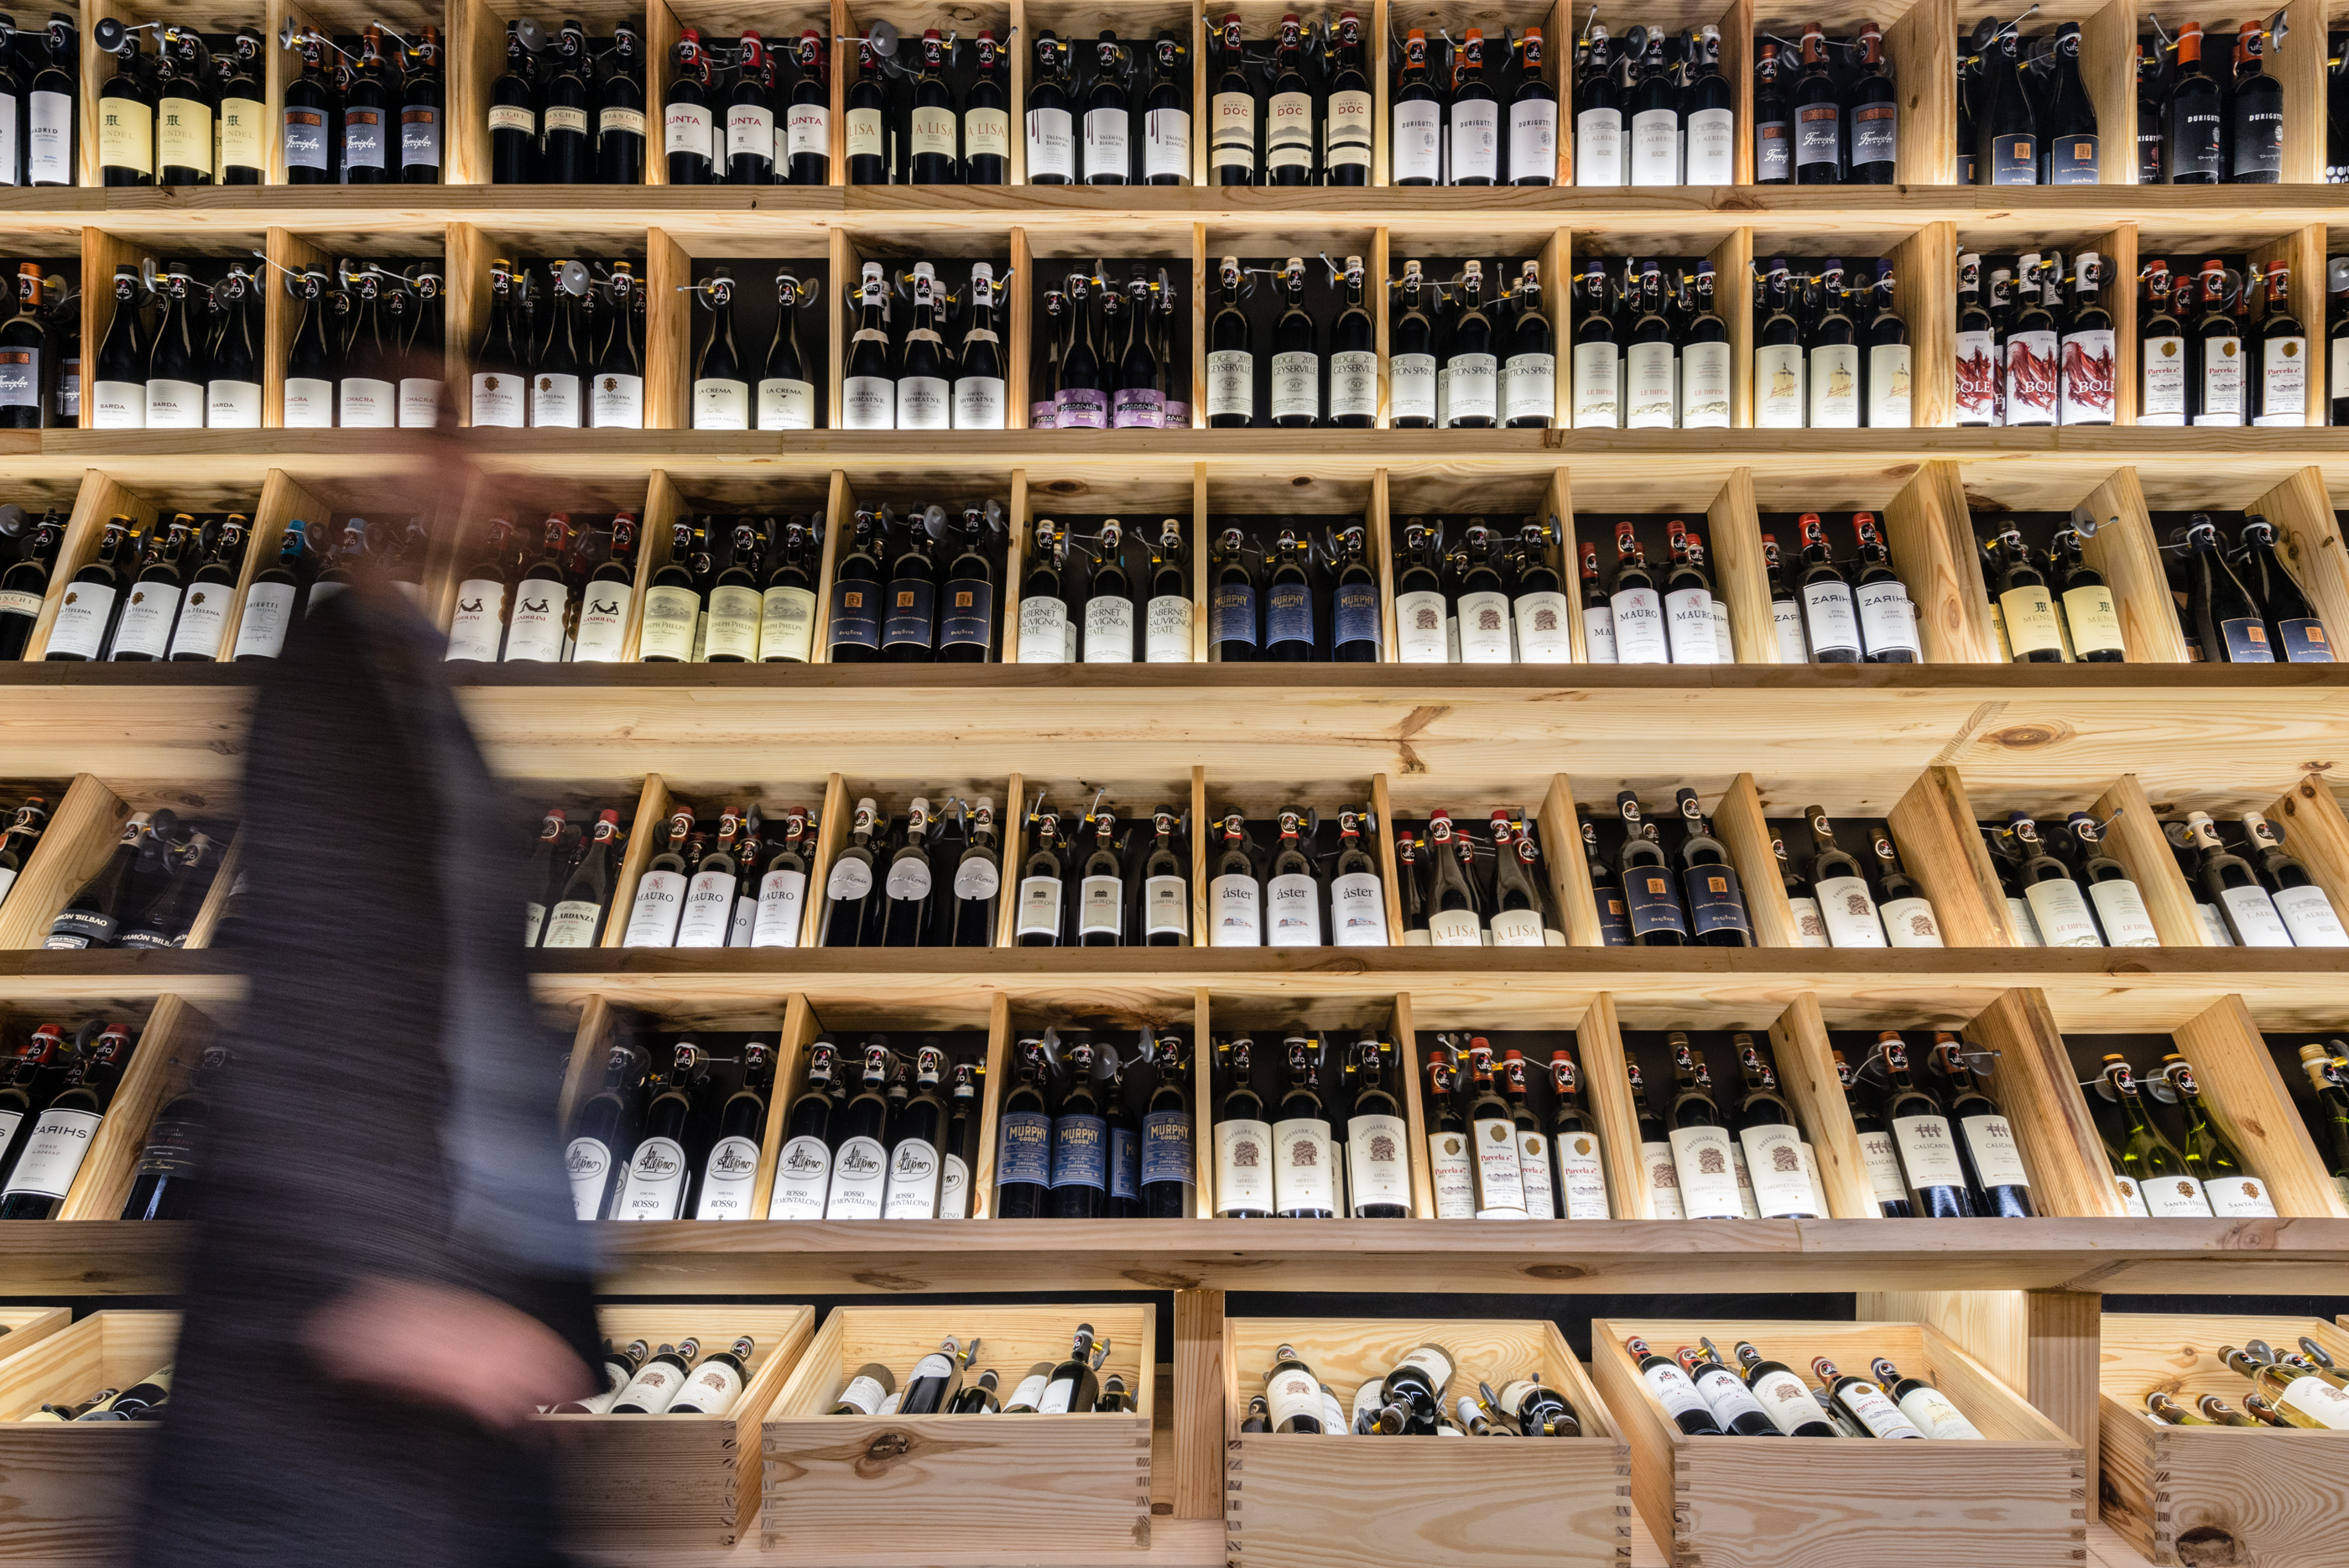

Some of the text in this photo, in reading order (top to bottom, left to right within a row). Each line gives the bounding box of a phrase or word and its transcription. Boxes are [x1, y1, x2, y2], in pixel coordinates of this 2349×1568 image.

[1223, 107, 1248, 117] DOC
[1278, 107, 1303, 117] DOC
[1338, 107, 1363, 116] DOC
[666, 116, 701, 126] LUNTA
[1402, 120, 1435, 129] DURIGUTTI
[1460, 120, 1493, 129] DURIGUTTI
[1518, 120, 1552, 129] DURIGUTTI
[915, 123, 954, 138] A LISA
[967, 123, 1006, 138] A LISA
[1046, 140, 1068, 148] BIANCHI
[1099, 140, 1122, 148] BIANCHI
[1209, 353, 1251, 364] RIDGE 2015
[1274, 354, 1316, 365] RIDGE 2015
[1333, 353, 1376, 365] RIDGE 2015
[1208, 364, 1252, 374] GEYSERVILLE
[1273, 364, 1316, 376] GEYSERVILLE
[1333, 364, 1377, 375] GEYSERVILLE
[2148, 367, 2171, 375] Parcela
[2209, 367, 2232, 375] Parcela
[489, 392, 513, 401] HELENA
[543, 392, 566, 401] HELENA
[774, 388, 803, 396] CREMA
[152, 401, 178, 409] BARDA
[211, 401, 233, 409] BARDA
[346, 396, 374, 404] CHACRA
[848, 396, 885, 404] MORAINE
[904, 396, 941, 404] MORAINE
[1149, 599, 1173, 610] RIDGE
[1215, 595, 1248, 605] MURPHY
[1270, 595, 1304, 606] MURPHY
[1341, 595, 1374, 606] MURPHY
[65, 607, 91, 615] HELENA
[132, 607, 159, 615] HELENA
[1050, 601, 1065, 612] 2014
[1115, 601, 1130, 611] 2014
[192, 607, 220, 617] HELENA
[1149, 608, 1187, 619] CABERNET
[1619, 609, 1658, 622] MAURO
[1676, 609, 1712, 622] MAURO
[662, 622, 685, 632] PHELPS
[731, 622, 754, 632] PHELPS
[1148, 617, 1193, 629] SAUVIGNON
[1149, 626, 1174, 636] ESTATE
[638, 891, 674, 903] MAURO
[75, 914, 108, 927] BILBAO
[560, 912, 595, 924] ARDANZA
[1497, 924, 1539, 941] A LISA
[2056, 923, 2091, 932] LE DIFESE
[1435, 925, 1477, 941] A LISA
[1008, 1125, 1048, 1140] MURPHY
[1060, 1128, 1099, 1141] MURPHY
[1150, 1124, 1190, 1139] MURPHY
[1282, 1128, 1310, 1145] FREEMARK
[1223, 1129, 1253, 1145] FREEMARK
[1685, 1137, 1715, 1153] FREEMARK
[1913, 1143, 1951, 1151] CALICANTO
[1481, 1154, 1503, 1163] Parcela
[1435, 1167, 1458, 1175] Parcela
[632, 1200, 659, 1208] ROSSO
[711, 1200, 737, 1208] ROSSO
[779, 1197, 820, 1207] MONTALCINO
[837, 1197, 878, 1207] MONTALCINO
